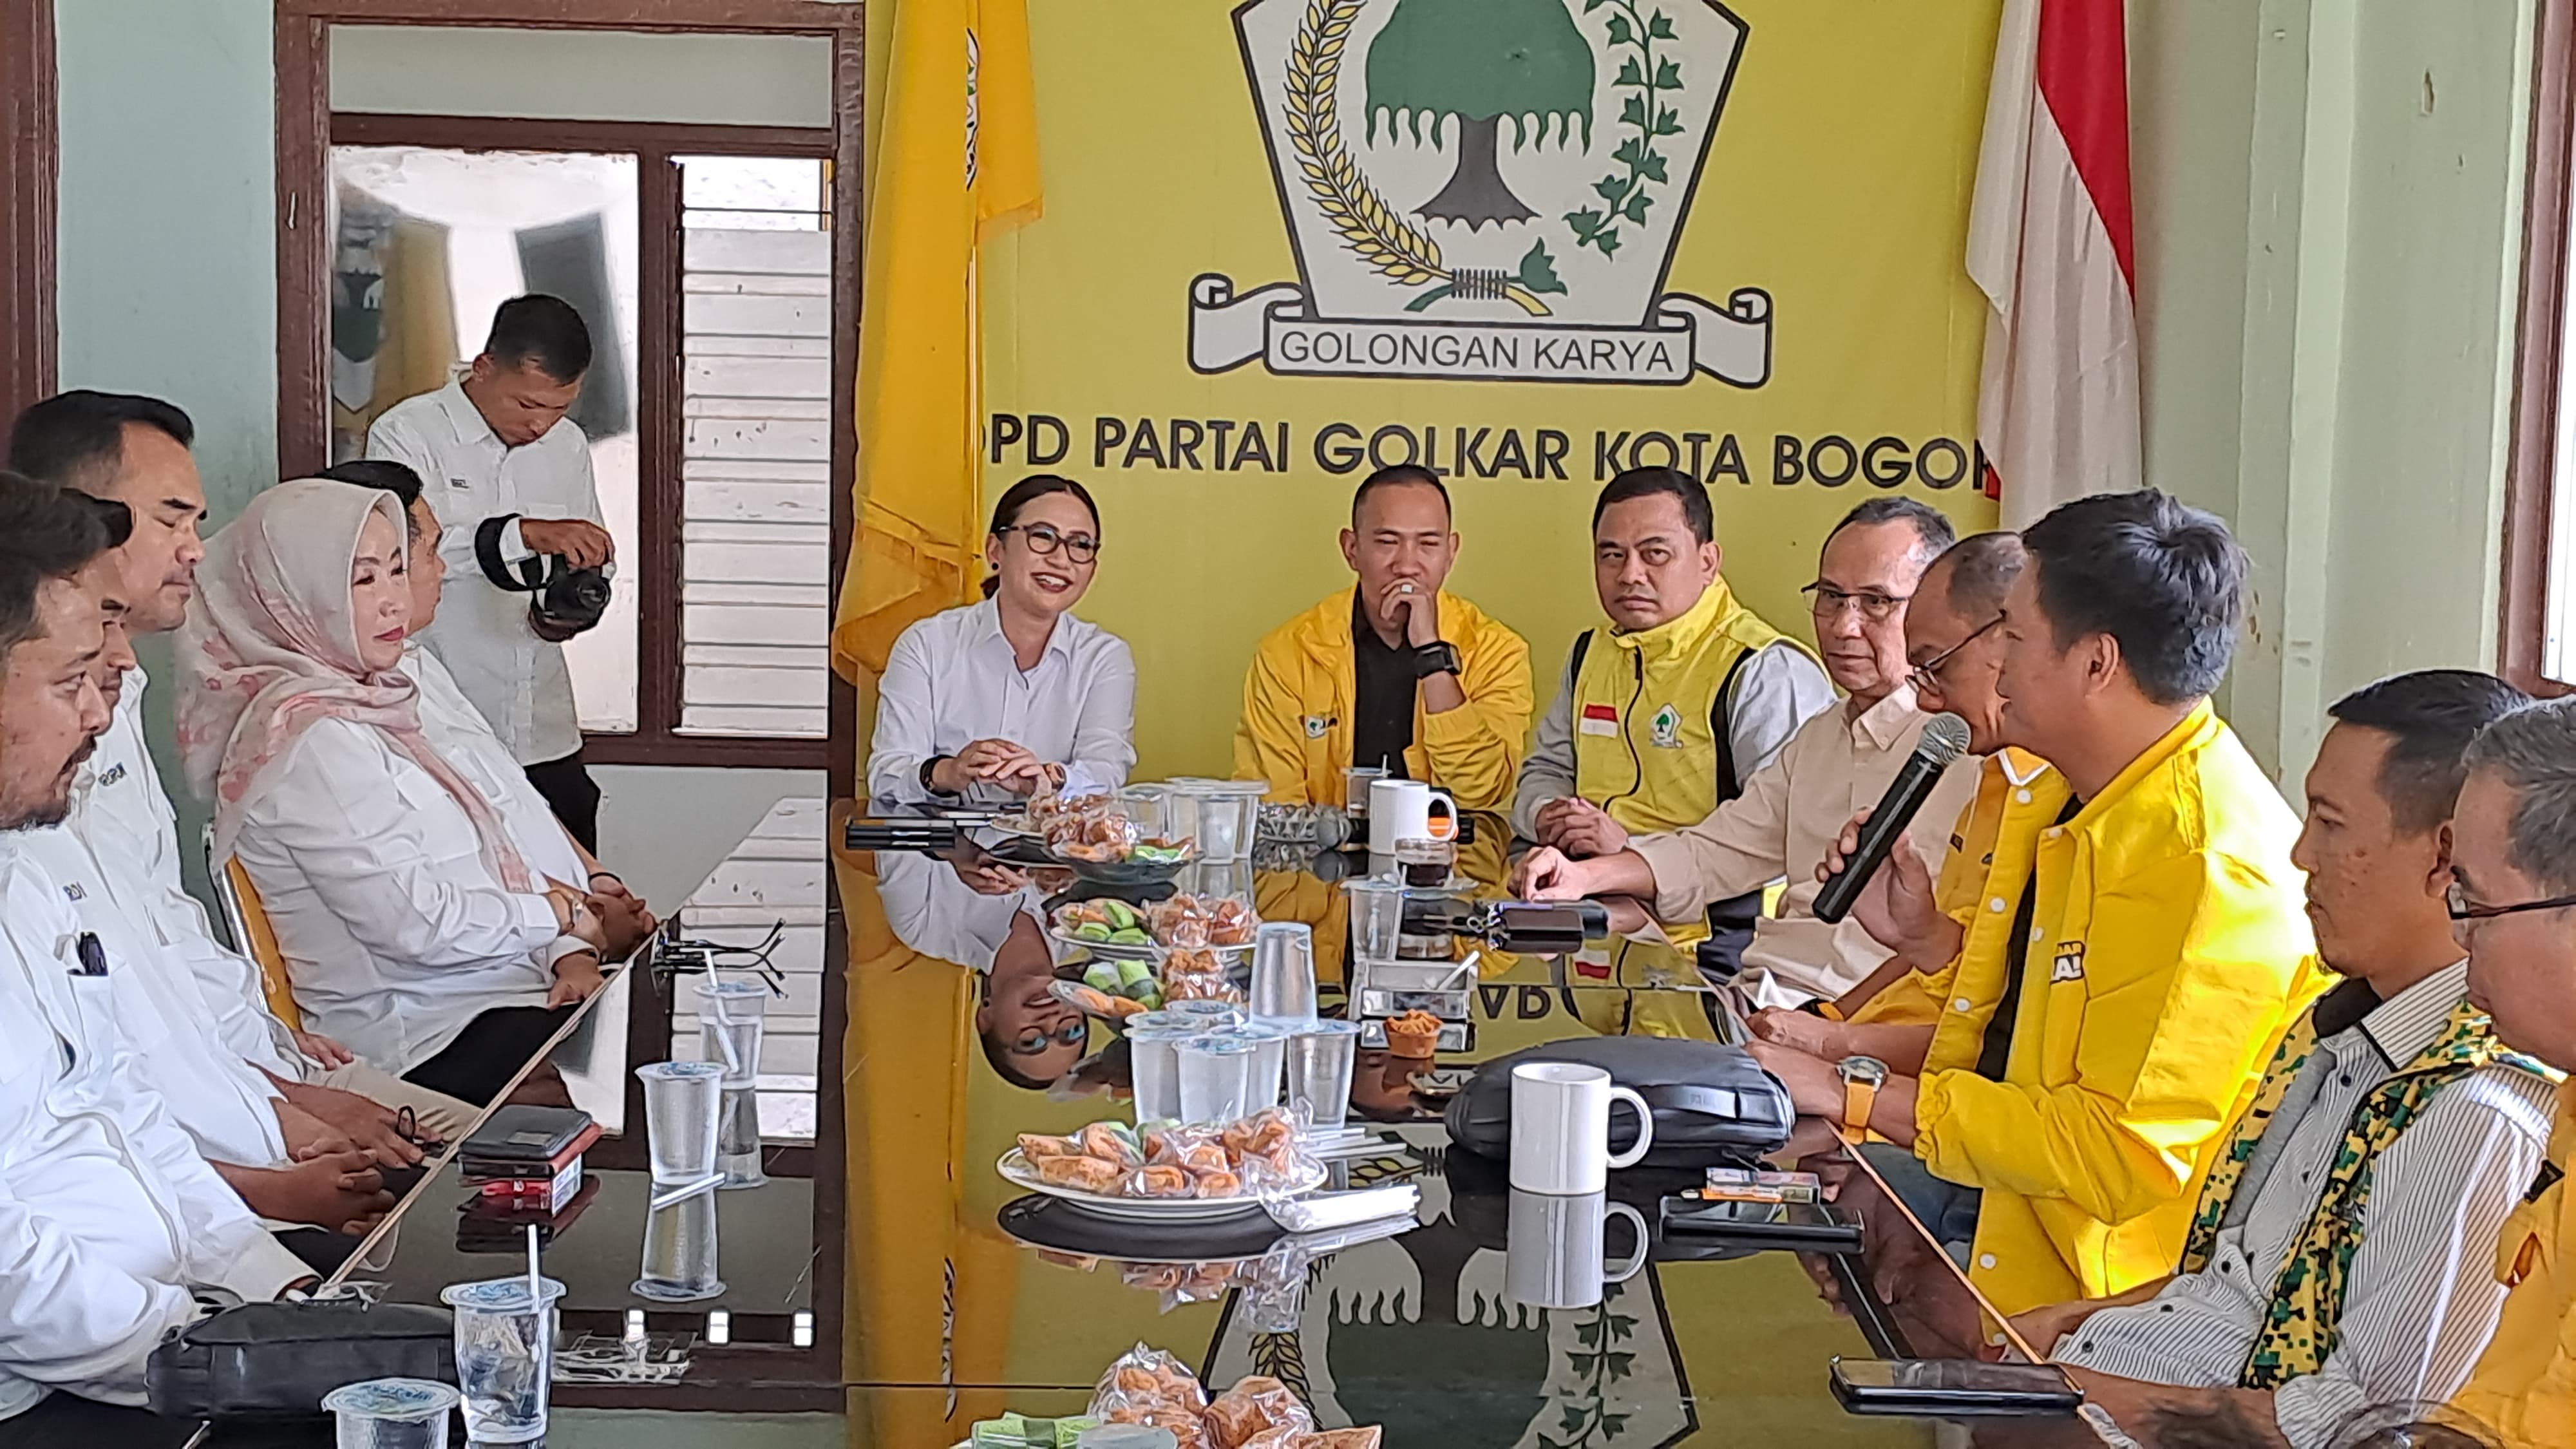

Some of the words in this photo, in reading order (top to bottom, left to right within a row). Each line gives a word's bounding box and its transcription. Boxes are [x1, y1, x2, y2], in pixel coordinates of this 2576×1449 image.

[1280, 330, 1519, 368] GOLONGAN
[1534, 338, 1674, 373] KARYA
[981, 413, 1070, 465] PD
[1095, 417, 1289, 473] PARTAI
[1313, 422, 1569, 480] GOLKAR
[1594, 431, 1750, 486] KOTA
